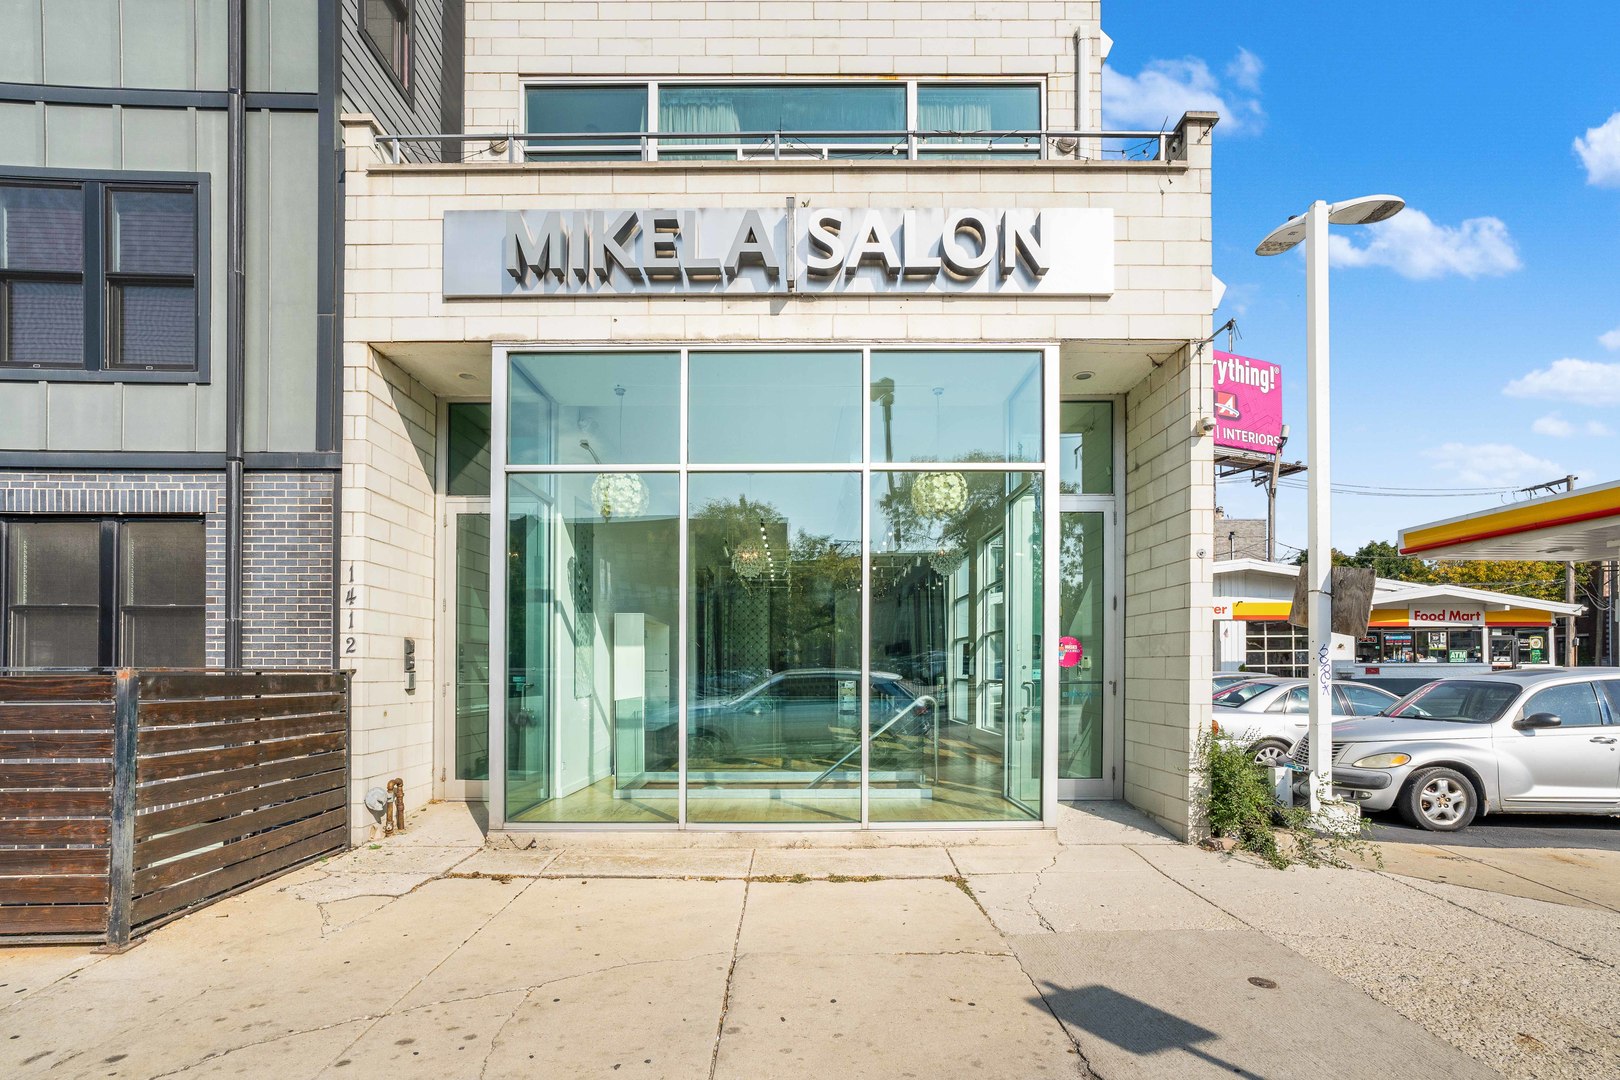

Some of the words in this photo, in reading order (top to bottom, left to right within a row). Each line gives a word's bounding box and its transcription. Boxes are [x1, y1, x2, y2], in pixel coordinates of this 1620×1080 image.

[506, 209, 779, 281] MIKELA
[805, 208, 1051, 280] SALON
[1223, 427, 1280, 447] INTERIORS
[1414, 609, 1445, 621] Food
[1449, 610, 1481, 622] Mart
[1450, 651, 1466, 659] ATM
